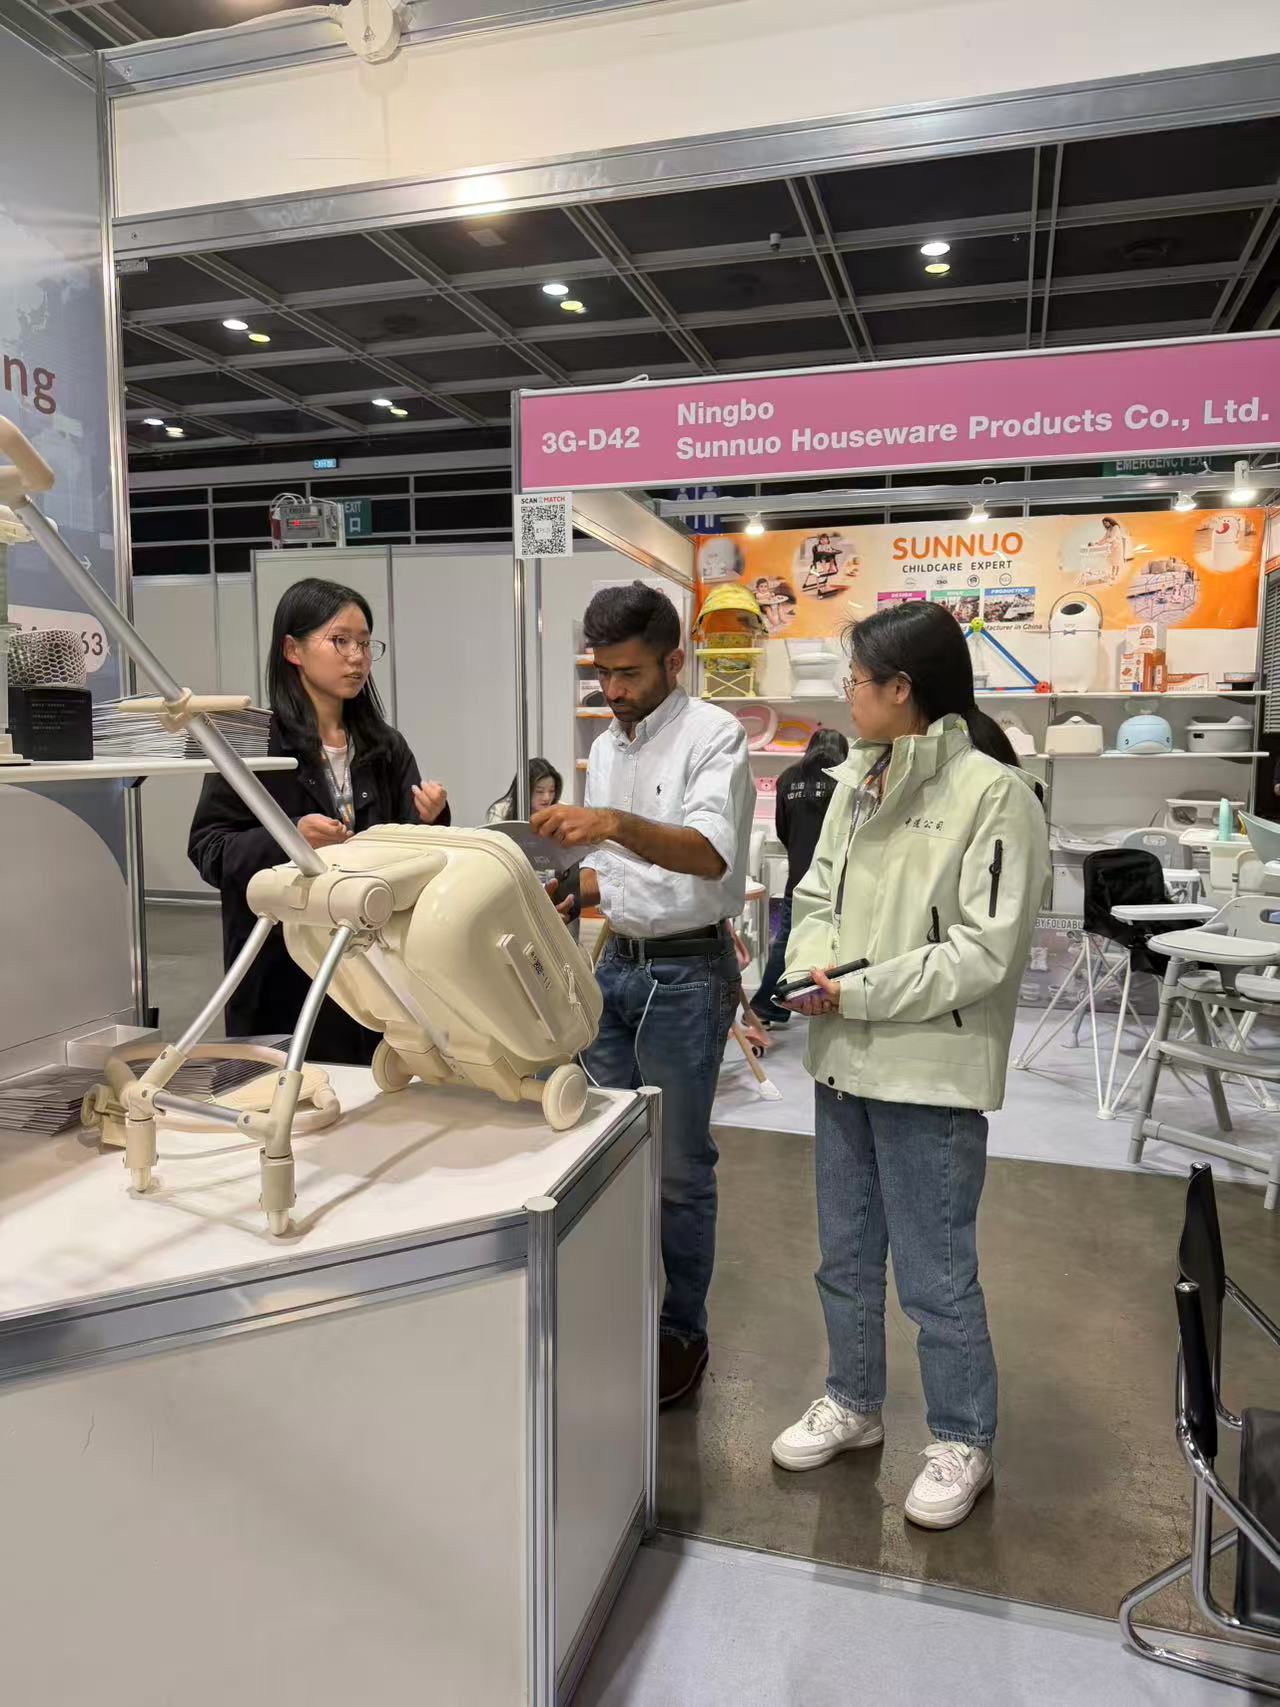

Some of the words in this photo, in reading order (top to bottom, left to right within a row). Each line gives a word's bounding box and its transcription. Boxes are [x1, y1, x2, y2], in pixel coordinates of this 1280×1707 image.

[677, 398, 774, 427] Ningbo
[541, 426, 640, 454] 3G-D42
[676, 435, 782, 460] Sunnuo
[791, 423, 958, 452] Houseware
[968, 409, 1113, 440] Products
[1124, 404, 1190, 432] Co.,
[1203, 397, 1270, 425] Ltd.
[1115, 457, 1184, 471] EMERGENCY
[892, 532, 1023, 560] SUNNUO
[902, 562, 963, 573] CHILDCARE
[970, 560, 1012, 571] EXPERT
